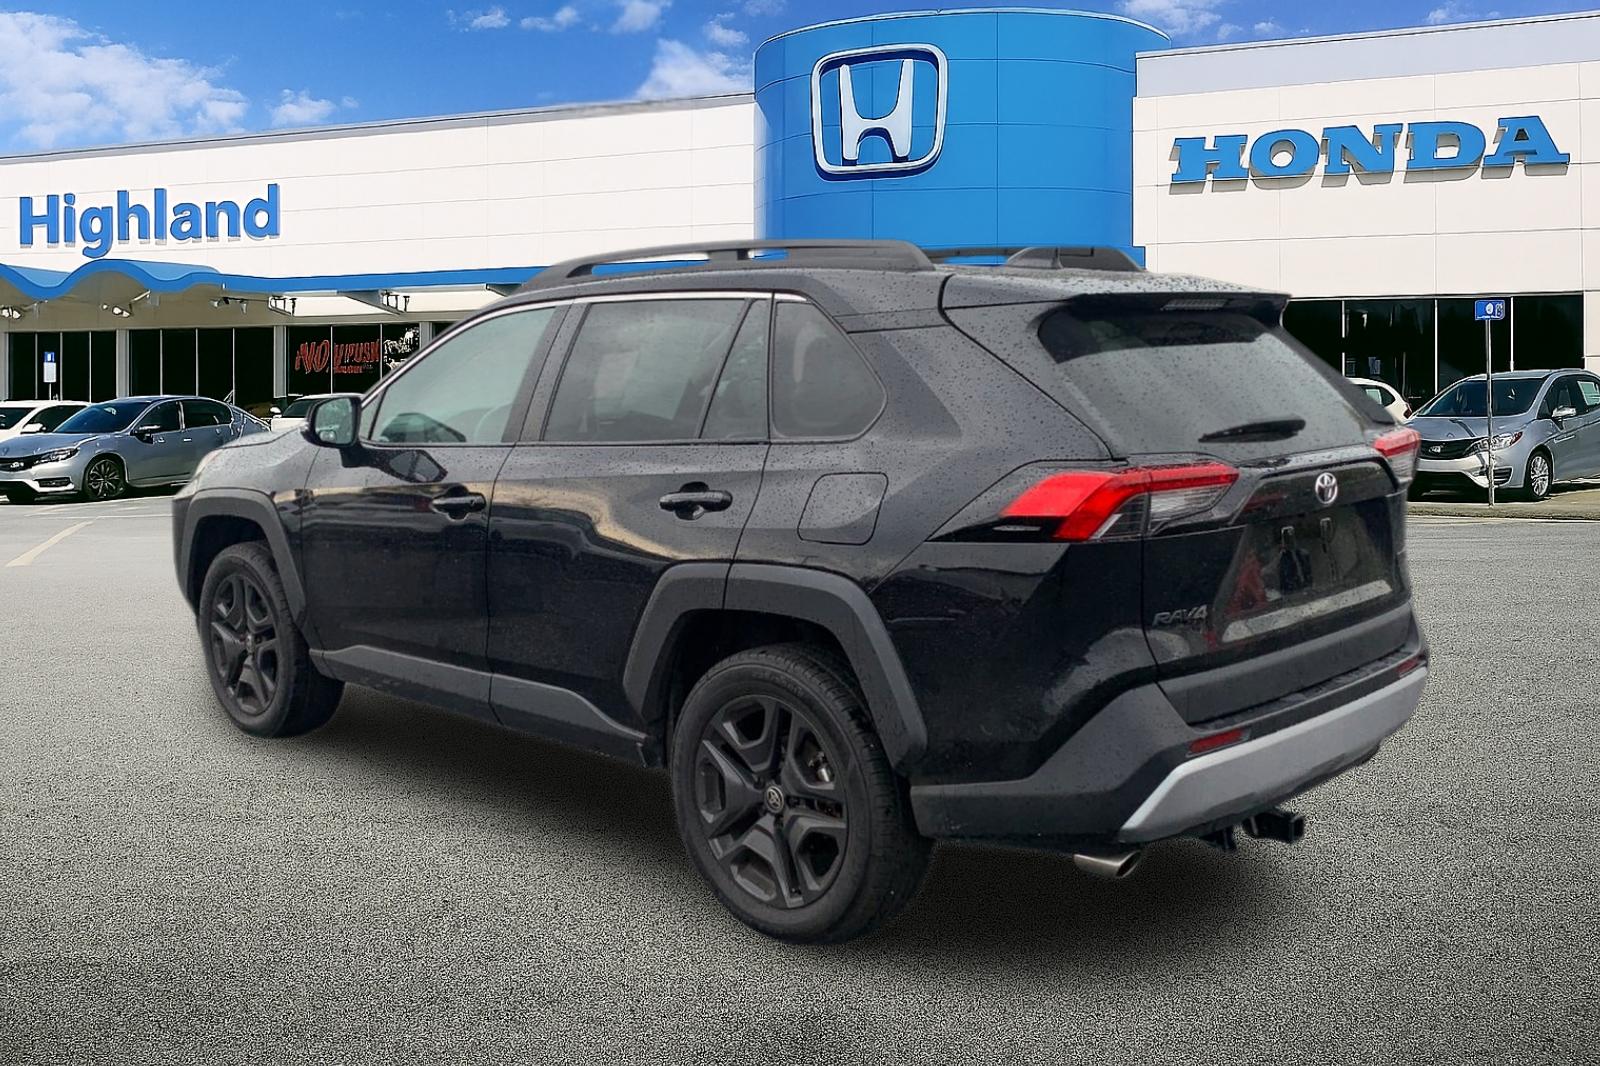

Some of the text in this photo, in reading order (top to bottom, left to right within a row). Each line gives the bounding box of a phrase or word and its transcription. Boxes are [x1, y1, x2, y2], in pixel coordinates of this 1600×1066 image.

[1171, 115, 1570, 184] HONDA
[19, 183, 281, 258] Highland
[1152, 604, 1208, 627] RAV4
